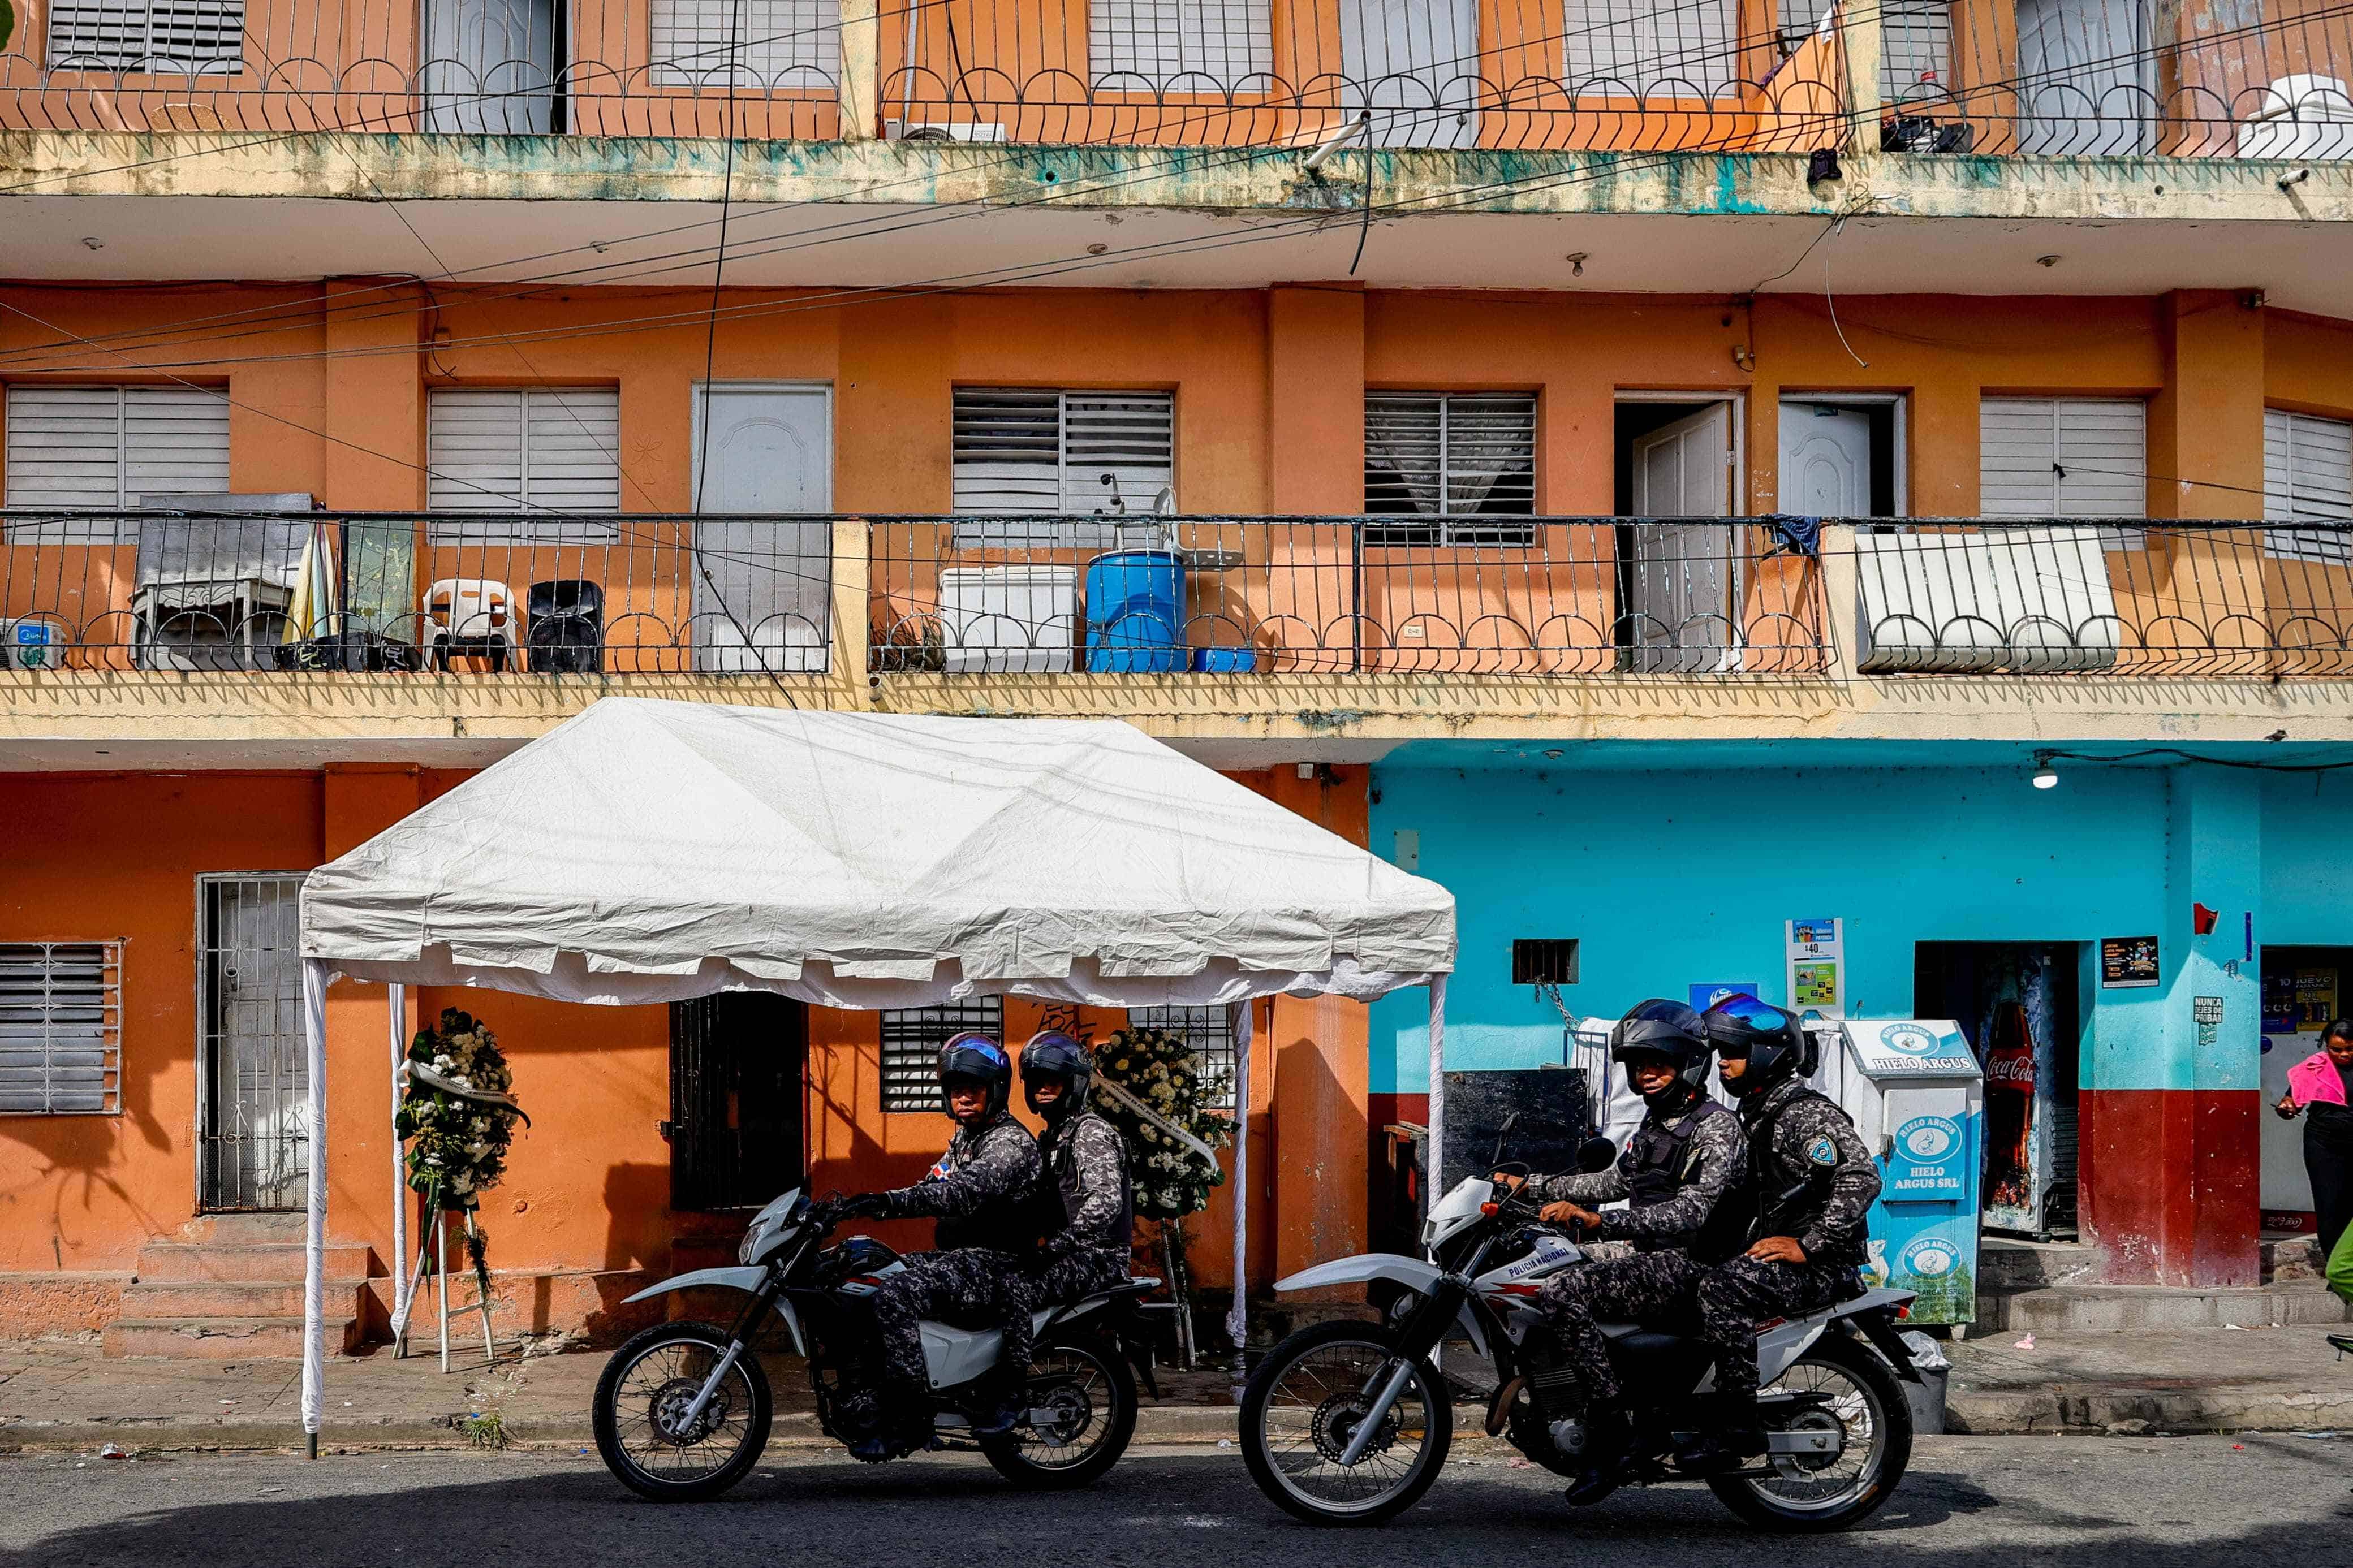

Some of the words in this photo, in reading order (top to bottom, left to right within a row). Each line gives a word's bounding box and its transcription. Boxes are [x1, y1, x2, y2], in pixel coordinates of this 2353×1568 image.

[2195, 997, 2222, 1007] NUNCA
[2195, 1014, 2222, 1022] PROBAR
[1902, 1024, 1931, 1038] ARGUS
[1873, 1057, 1920, 1070] HIELO
[1921, 1057, 1972, 1070] ARGUS
[1137, 1103, 1146, 1111] PAZ
[1899, 1118, 1925, 1138] HIELO
[1927, 1117, 1956, 1135] ARGUS
[1909, 1167, 1945, 1177] HIELO
[1895, 1178, 1935, 1189] ARGUS
[1936, 1177, 1959, 1188] SRL
[1907, 1241, 1930, 1258] HIELO
[1931, 1240, 1956, 1256] ARGUS
[1508, 1260, 1537, 1277] POLICIA
[1536, 1247, 1570, 1267] NACIONAL
